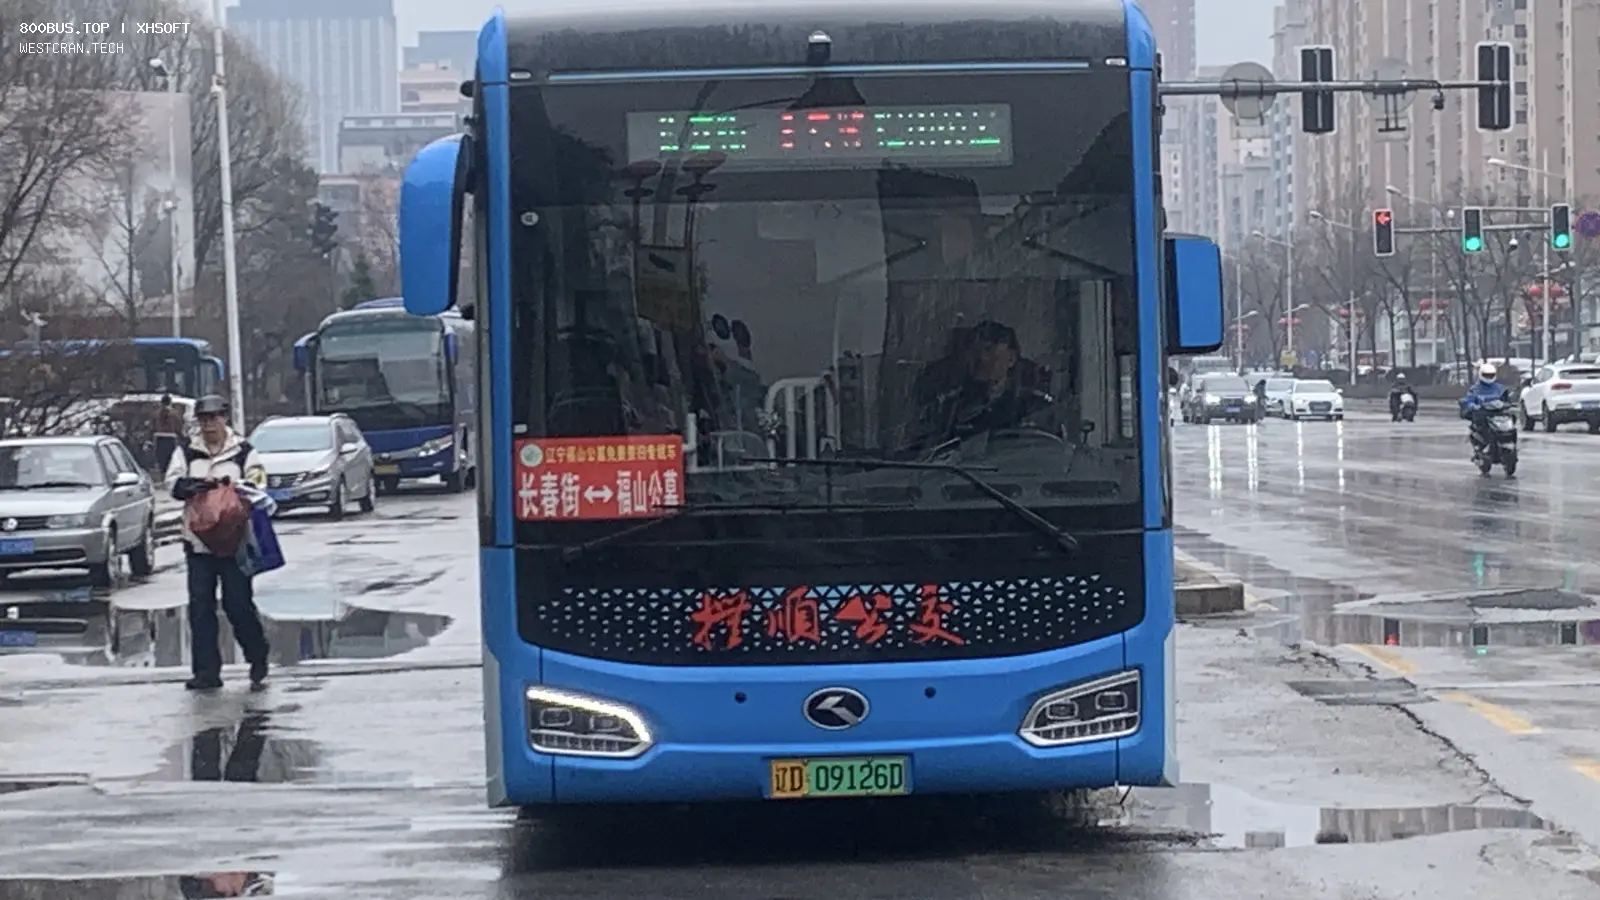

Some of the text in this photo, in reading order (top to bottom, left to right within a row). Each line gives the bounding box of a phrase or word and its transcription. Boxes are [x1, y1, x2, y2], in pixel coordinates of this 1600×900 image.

[518, 468, 679, 518] 长春街 福山公墓
